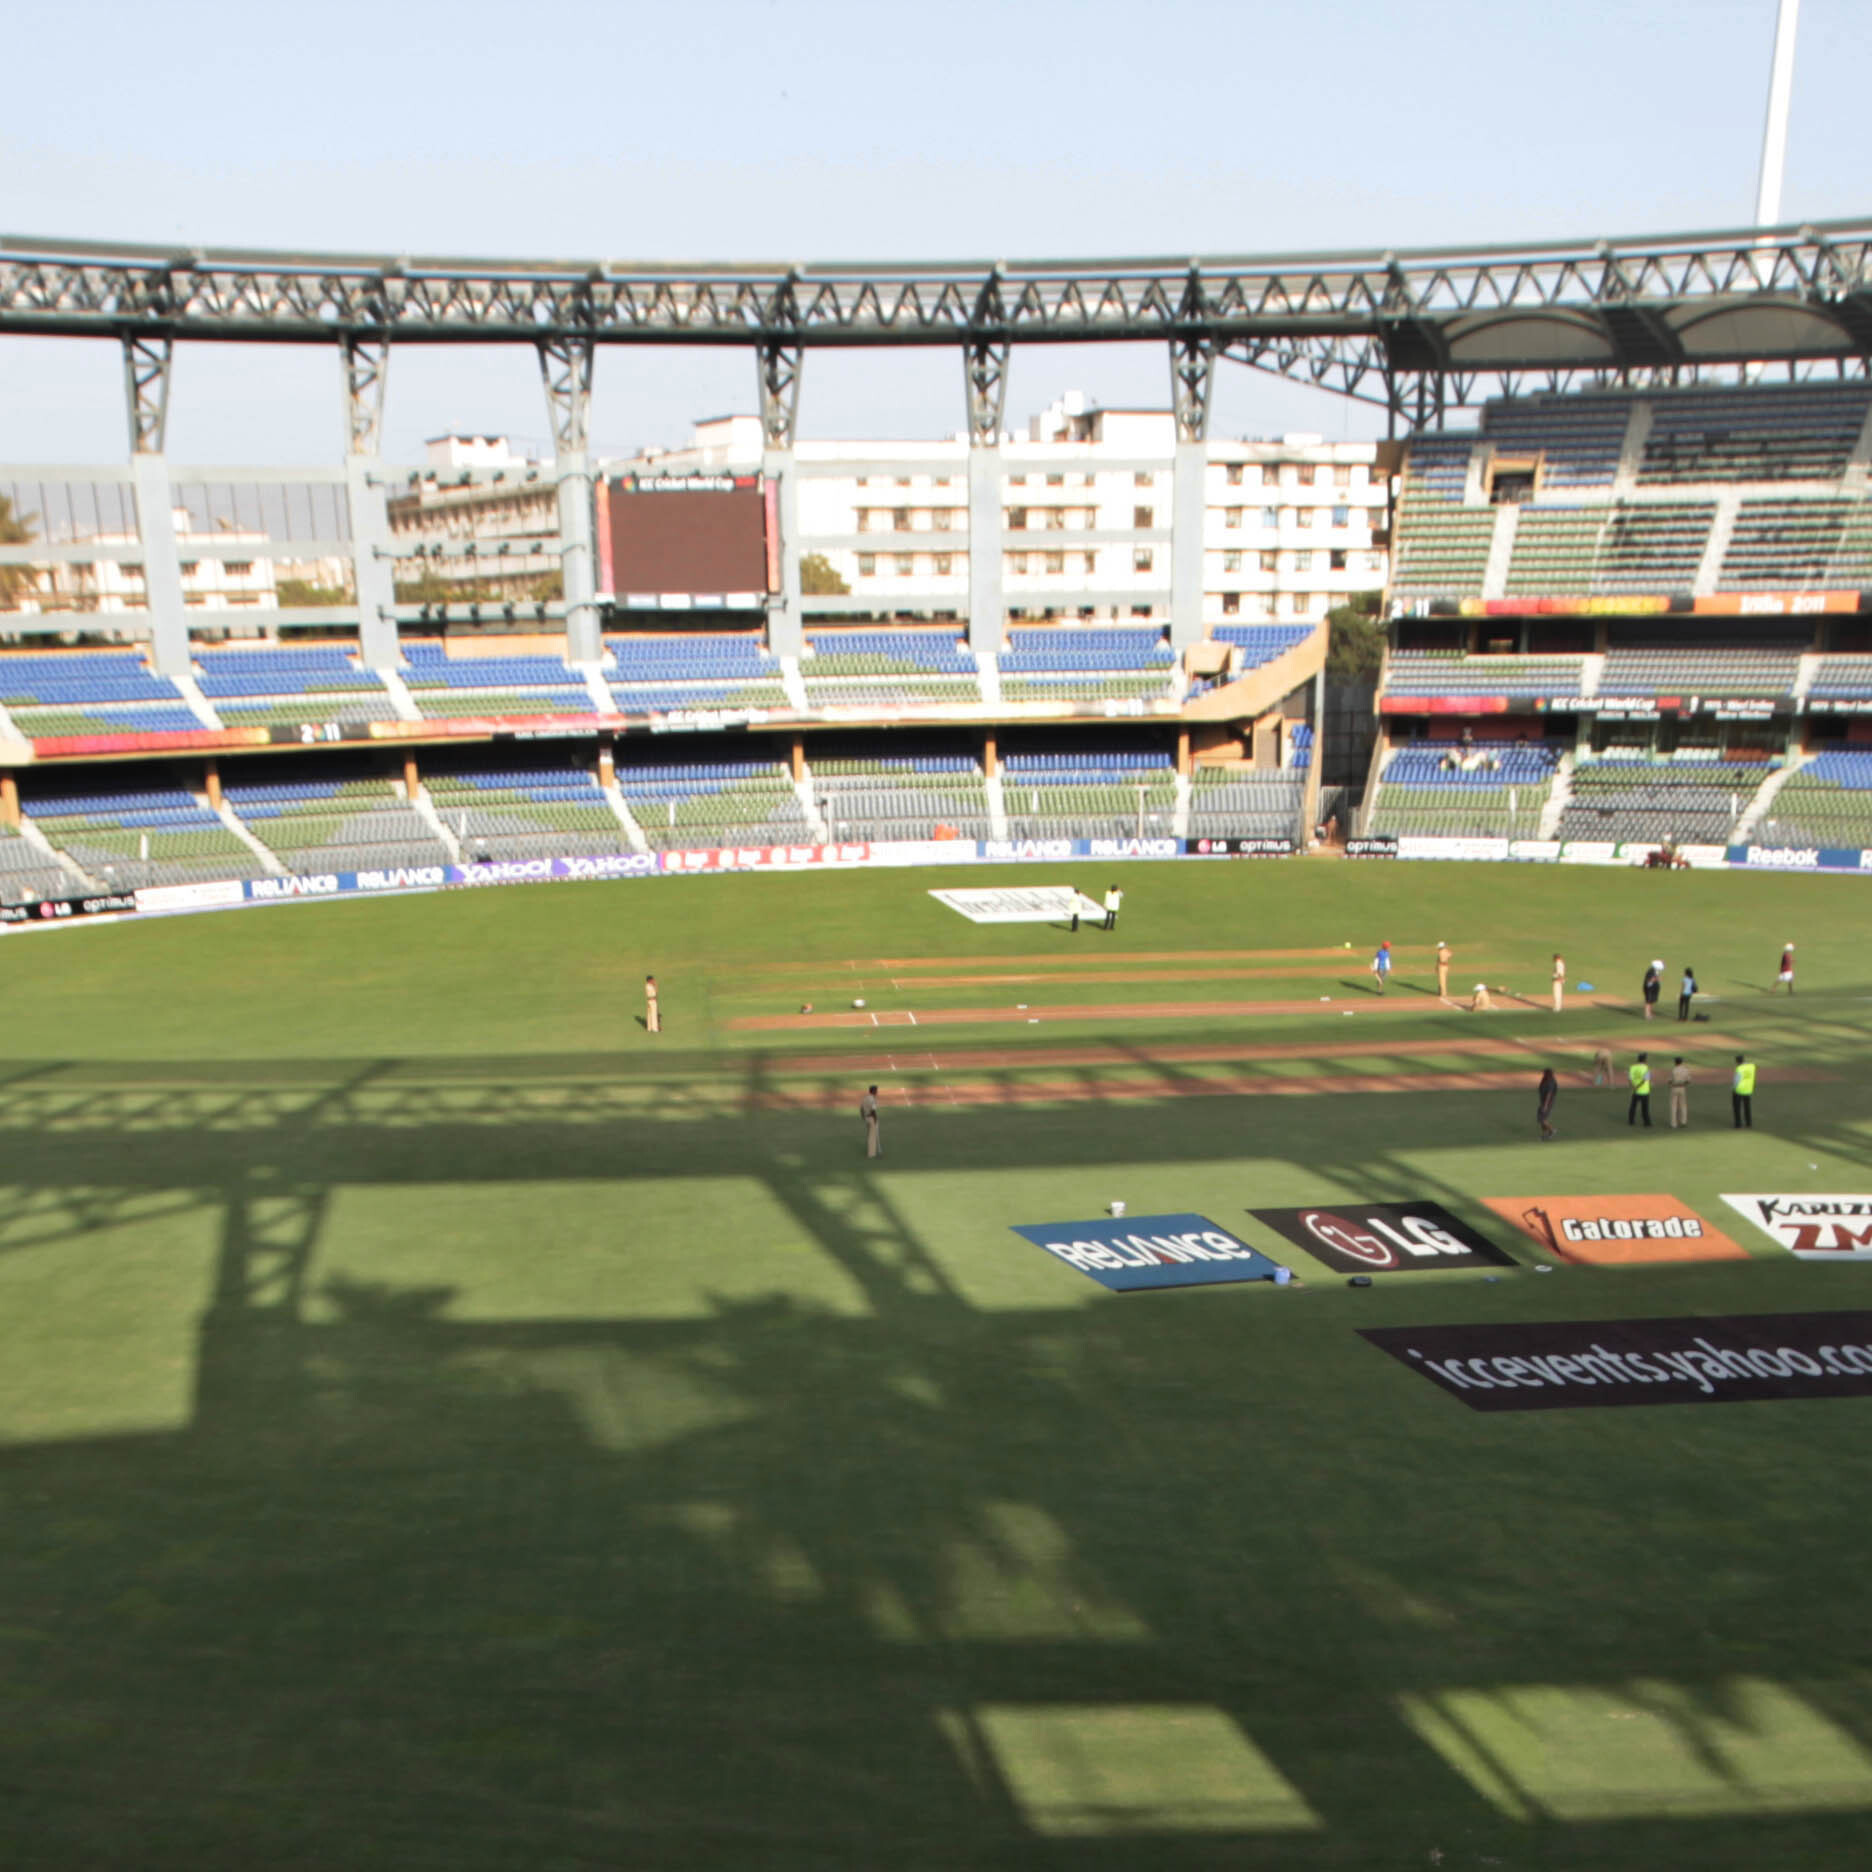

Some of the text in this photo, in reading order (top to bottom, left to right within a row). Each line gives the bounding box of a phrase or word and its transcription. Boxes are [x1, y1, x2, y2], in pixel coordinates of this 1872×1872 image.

[564, 853, 657, 877] YAHOO!
[1747, 845, 1819, 868] Reebok
[457, 860, 554, 884] YAHOO!
[1367, 1215, 1472, 1256] LG
[1560, 1215, 1703, 1242] Gatorade
